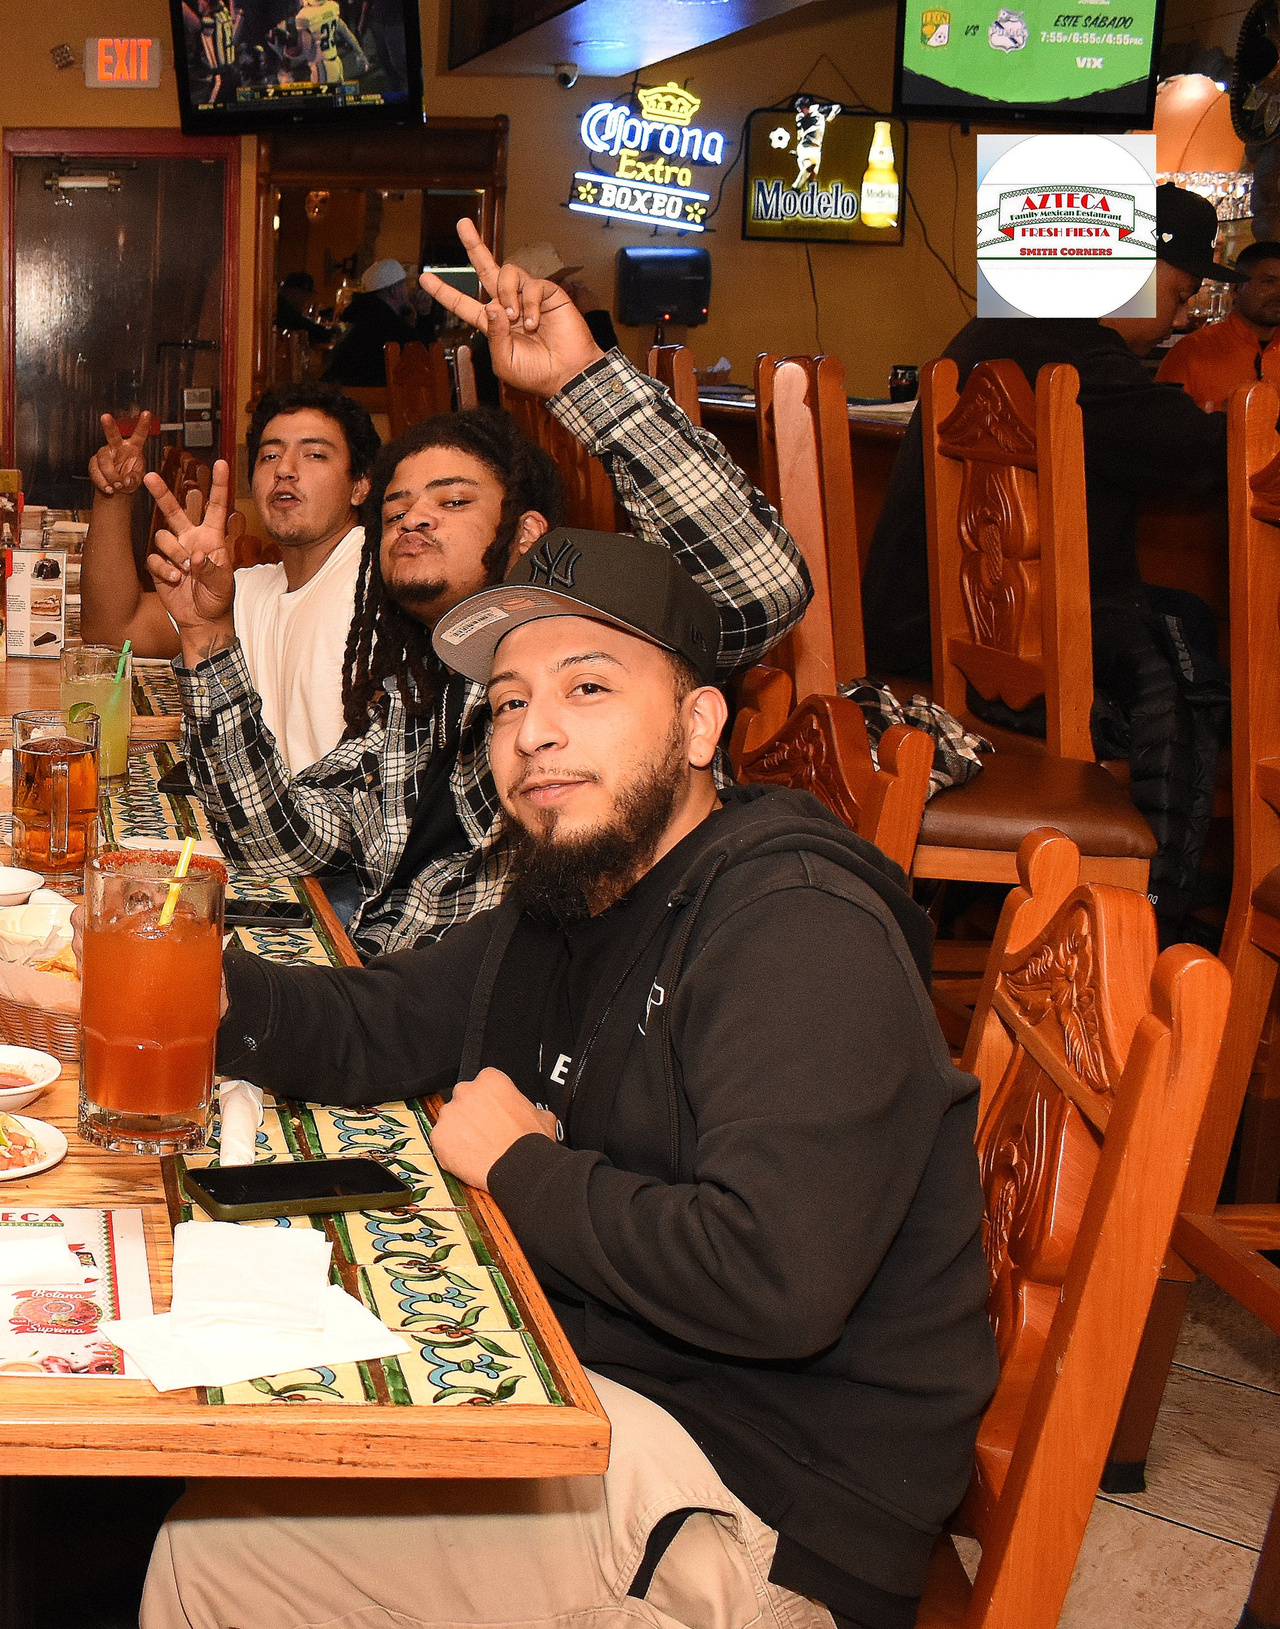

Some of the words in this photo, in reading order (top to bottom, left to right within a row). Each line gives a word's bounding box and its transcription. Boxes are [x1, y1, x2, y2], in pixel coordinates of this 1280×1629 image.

[1053, 15, 1082, 28] ESTE
[1082, 13, 1134, 29] SÁBADO
[97, 38, 152, 82] EXIT
[581, 102, 725, 165] Corona
[615, 148, 693, 187] Extra
[598, 183, 684, 219] BOXEO
[753, 179, 858, 220] Modelo
[529, 538, 582, 588] NY
[31, 1288, 86, 1299] Botana
[26, 1323, 86, 1335] Suprema
